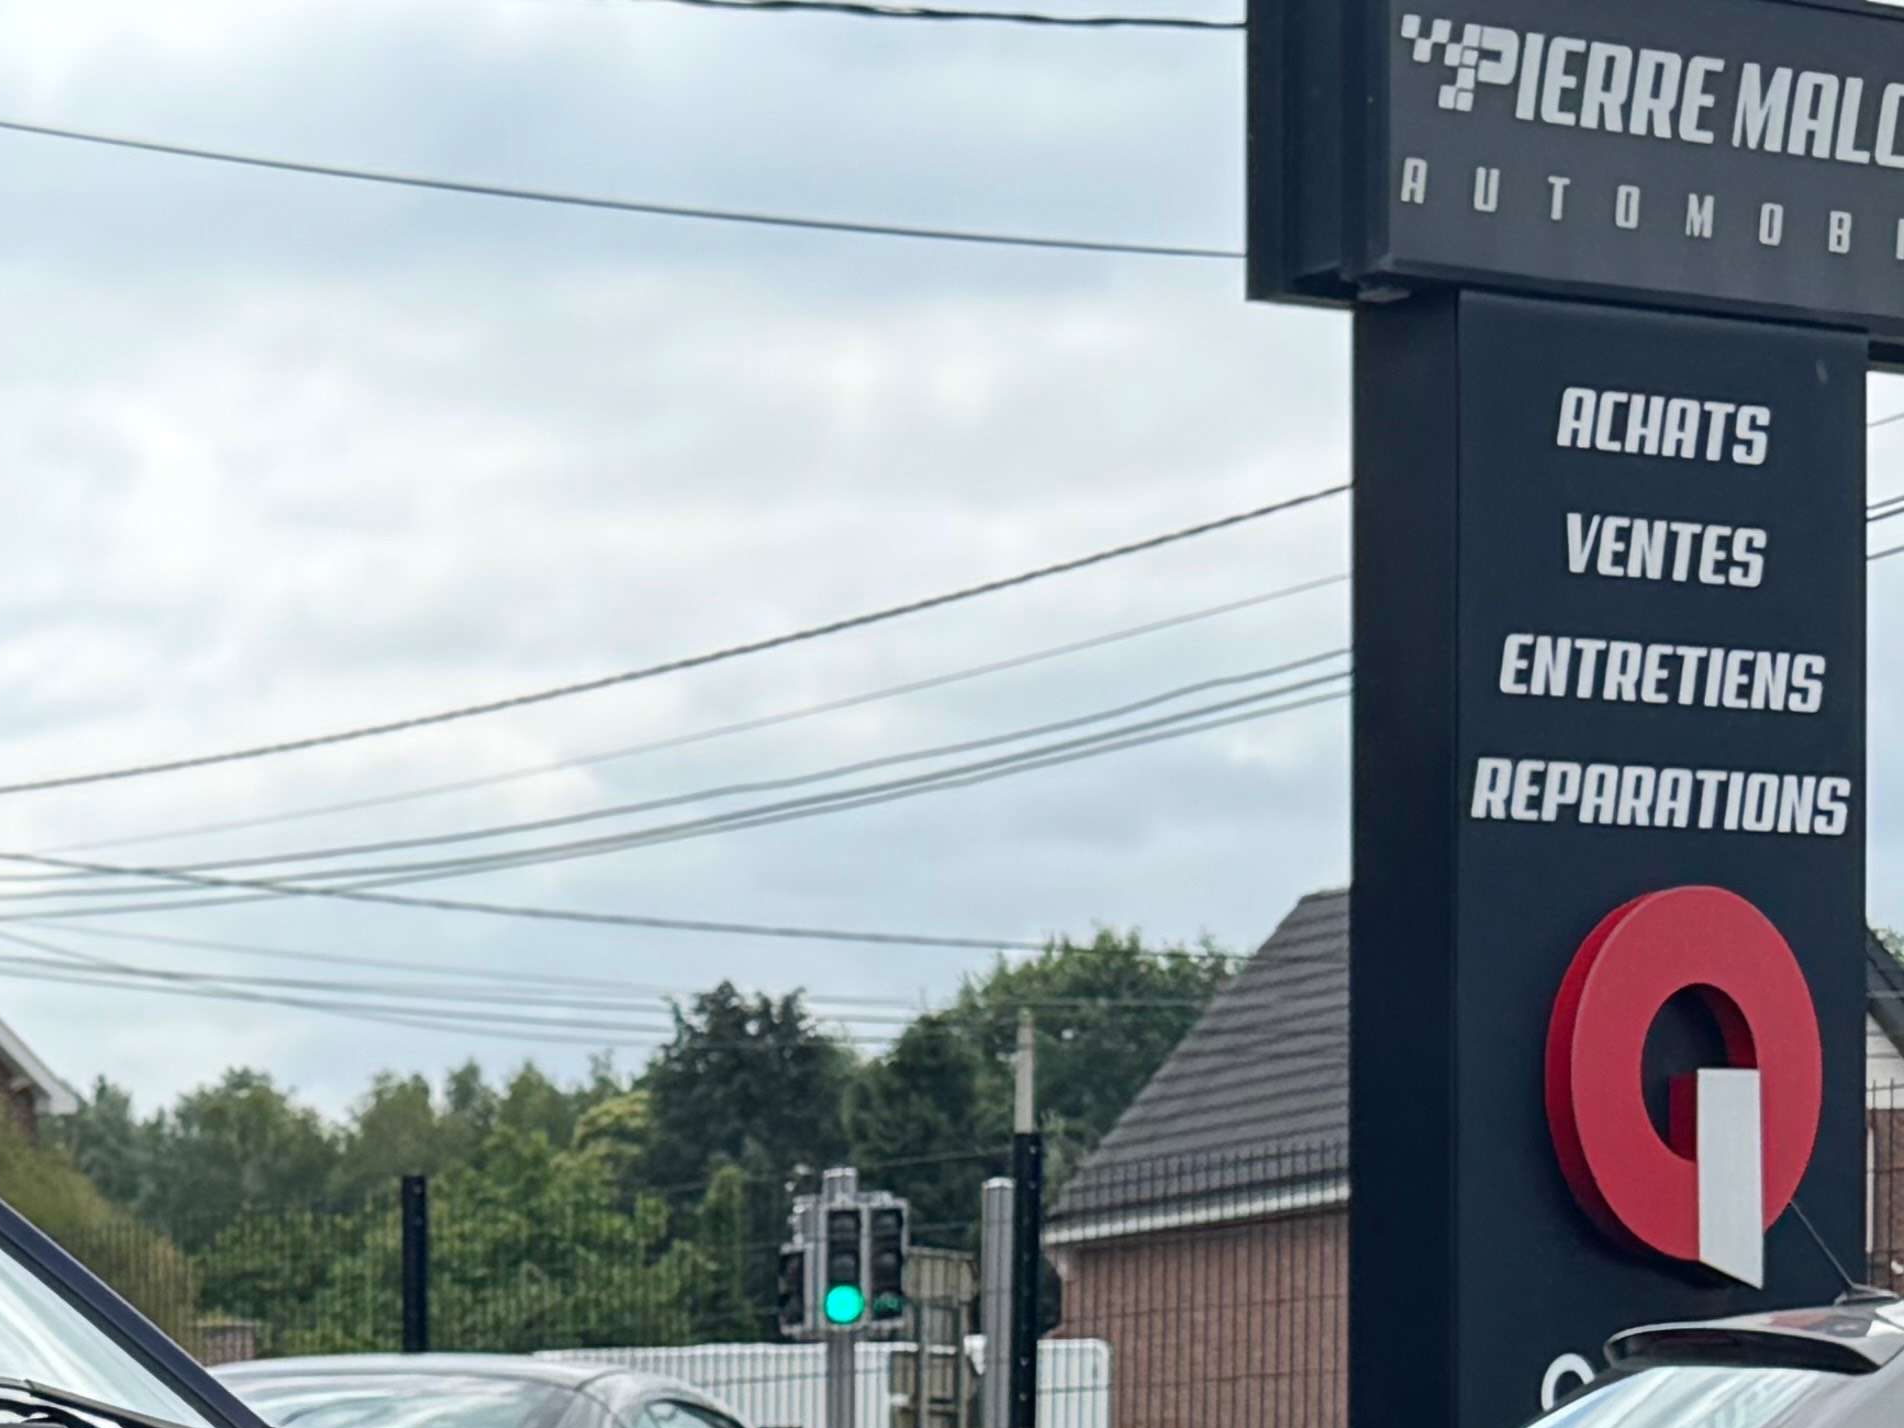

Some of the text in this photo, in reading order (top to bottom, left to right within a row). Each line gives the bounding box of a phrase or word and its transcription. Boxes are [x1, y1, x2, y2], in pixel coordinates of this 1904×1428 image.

[1439, 18, 1725, 144] PIERRE
[1556, 387, 1771, 465] ACHATS
[1567, 512, 1767, 588] VENTES
[1499, 633, 1826, 713] ENTRETIENS
[1471, 757, 1851, 835] REPARATIONS
